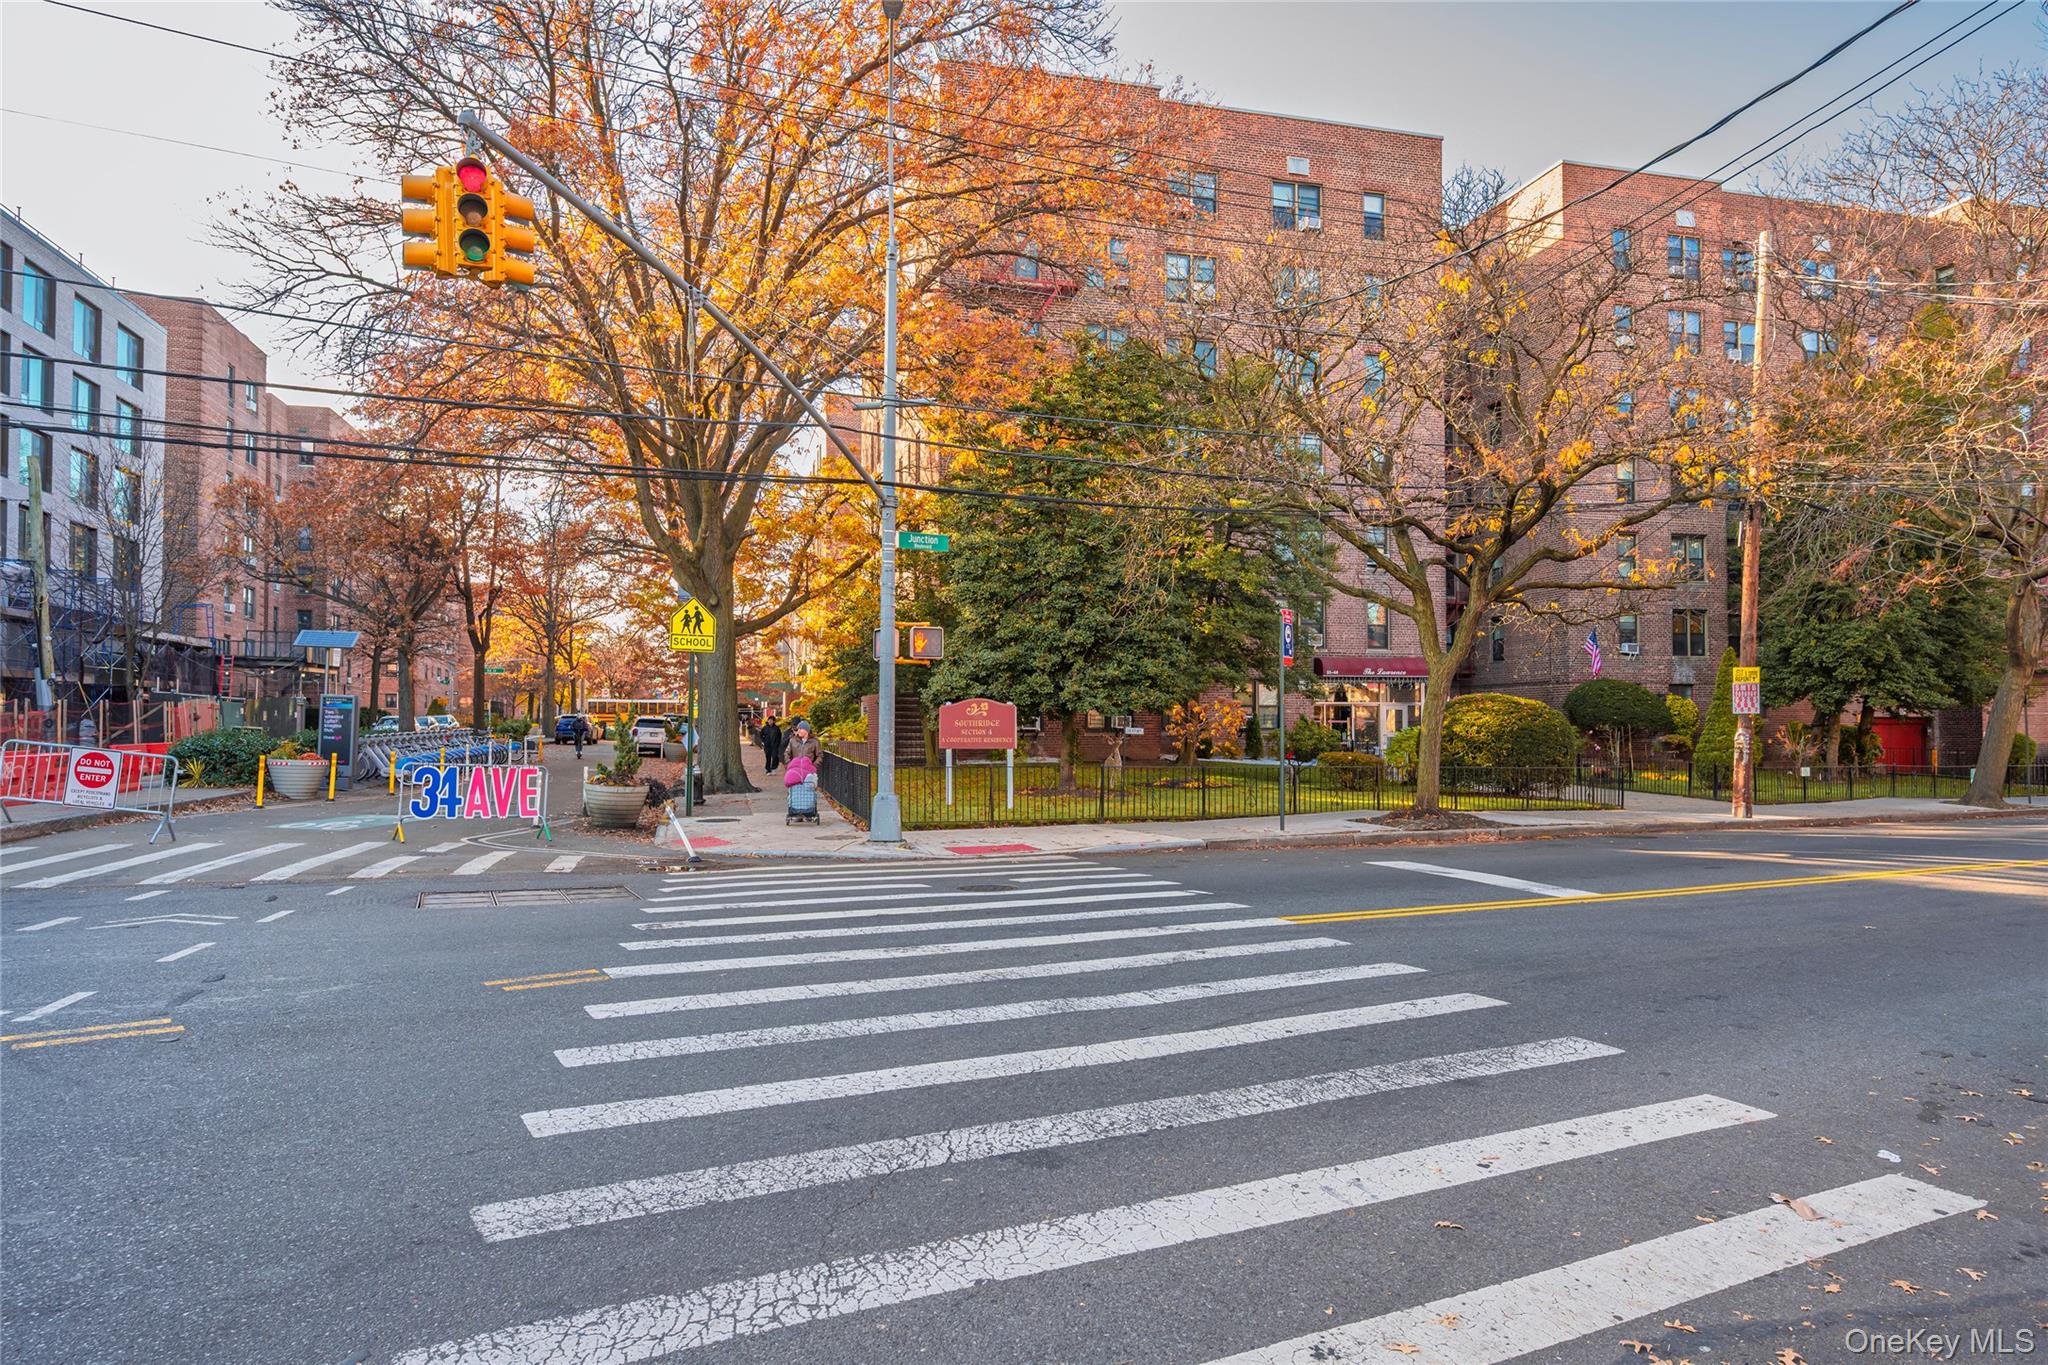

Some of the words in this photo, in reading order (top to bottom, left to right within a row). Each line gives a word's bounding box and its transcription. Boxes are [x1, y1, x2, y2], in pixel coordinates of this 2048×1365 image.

[908, 534, 939, 545] Junction
[673, 637, 712, 647] SCHOOL
[1363, 667, 1375, 675] The
[94, 759, 110, 767] NOT
[79, 773, 107, 782] ENTER
[409, 765, 464, 819] 34
[464, 764, 540, 819] AVE
